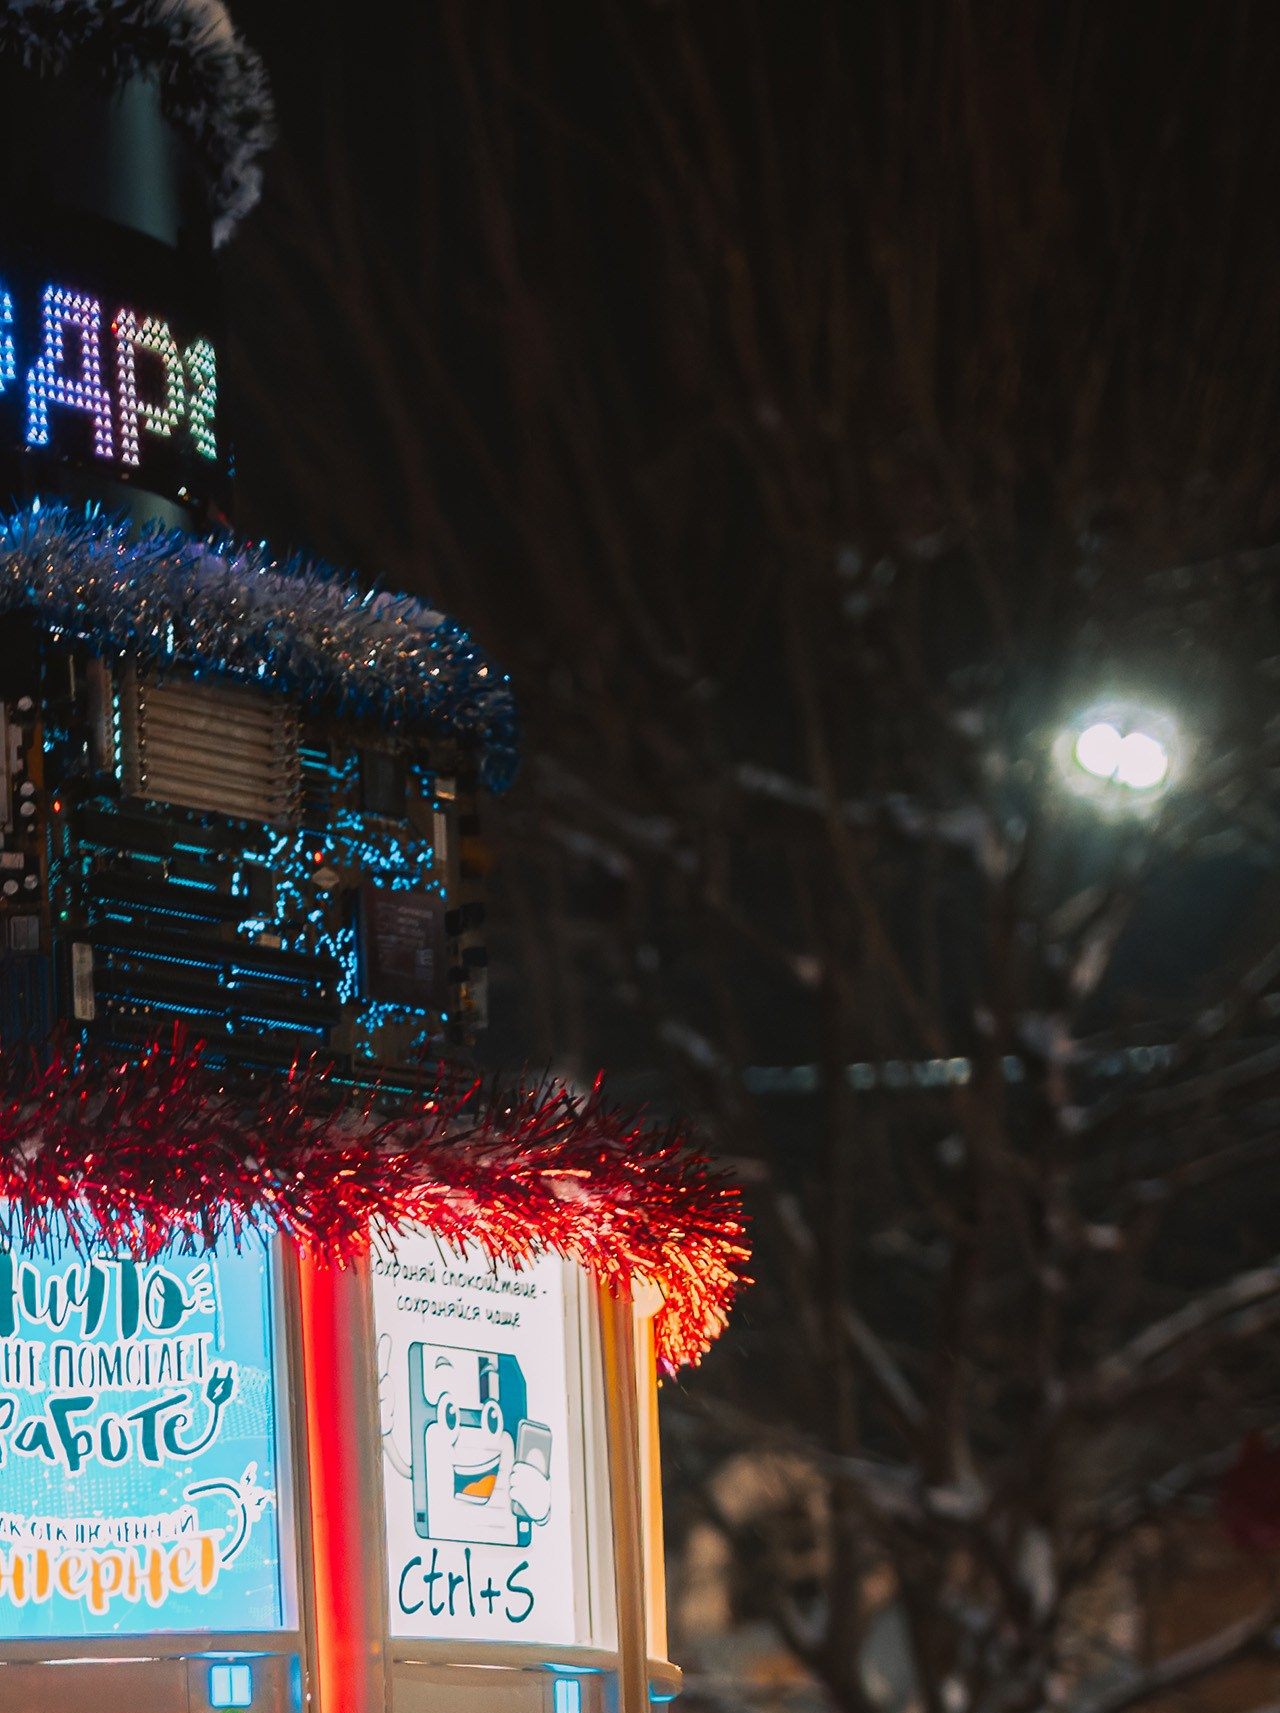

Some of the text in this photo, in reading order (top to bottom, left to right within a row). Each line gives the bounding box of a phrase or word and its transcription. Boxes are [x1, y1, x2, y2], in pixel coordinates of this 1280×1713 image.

[372, 1258, 437, 1288] охраняй
[396, 1294, 522, 1329] сохраняйся чаще
[54, 1337, 206, 1389] ПОМОГАЕТ
[398, 1547, 535, 1623] Ctrl+S
